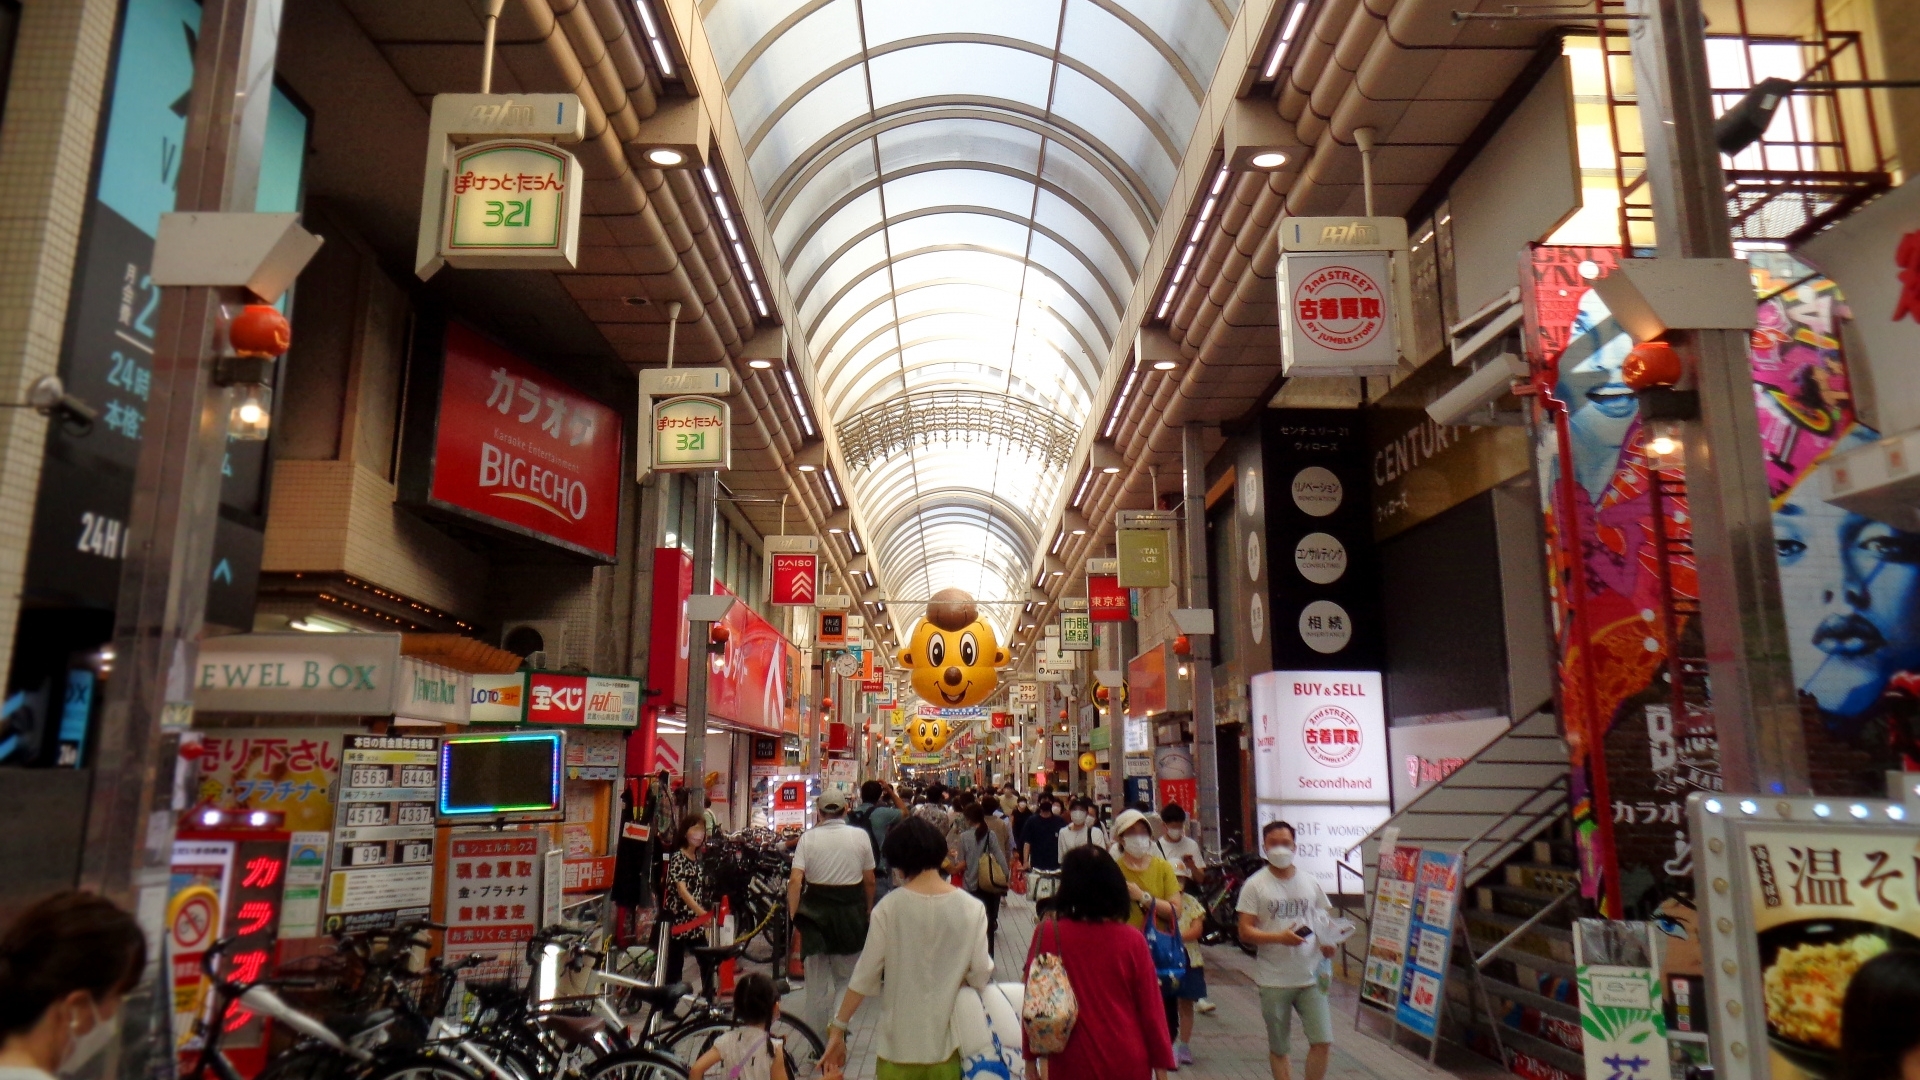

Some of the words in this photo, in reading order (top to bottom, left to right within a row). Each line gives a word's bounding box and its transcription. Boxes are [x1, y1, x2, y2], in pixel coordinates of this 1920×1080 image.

[482, 198, 532, 226] 321
[1305, 274, 1327, 293] 2nd
[1328, 270, 1374, 292] STREET
[1298, 298, 1381, 320] 古着買取
[1306, 321, 1319, 333] BY
[1318, 332, 1353, 344] JUMBLE
[1354, 321, 1375, 341] STORE
[486, 366, 593, 447] カラオケ
[676, 432, 705, 450] 321
[494, 428, 526, 449] Karaoke
[528, 442, 580, 474] Entertainment
[479, 442, 527, 489] BIG
[529, 464, 588, 520] ECHO
[1294, 481, 1340, 493] リノベーション
[777, 559, 812, 567] DAISO
[1090, 595, 1126, 607] 東京堂
[1307, 615, 1343, 630] 相続
[302, 660, 377, 690] BOX
[531, 684, 583, 711] 宝くじ
[1293, 683, 1323, 696] BUY
[1324, 687, 1332, 696] &
[1333, 683, 1366, 697] SELL
[1324, 708, 1355, 725] STREET
[1305, 729, 1361, 745] 古着買取
[353, 771, 386, 785] 8563
[403, 771, 433, 785] 8443
[1298, 776, 1373, 789] Secondhand
[349, 809, 382, 823] 4512
[400, 808, 429, 821] 4337
[1297, 822, 1321, 836] B1F
[362, 848, 378, 862] 99
[412, 846, 426, 859] 94
[1299, 845, 1322, 858] B2F
[456, 860, 532, 879] 現金買取
[458, 905, 525, 921] 無料査定
